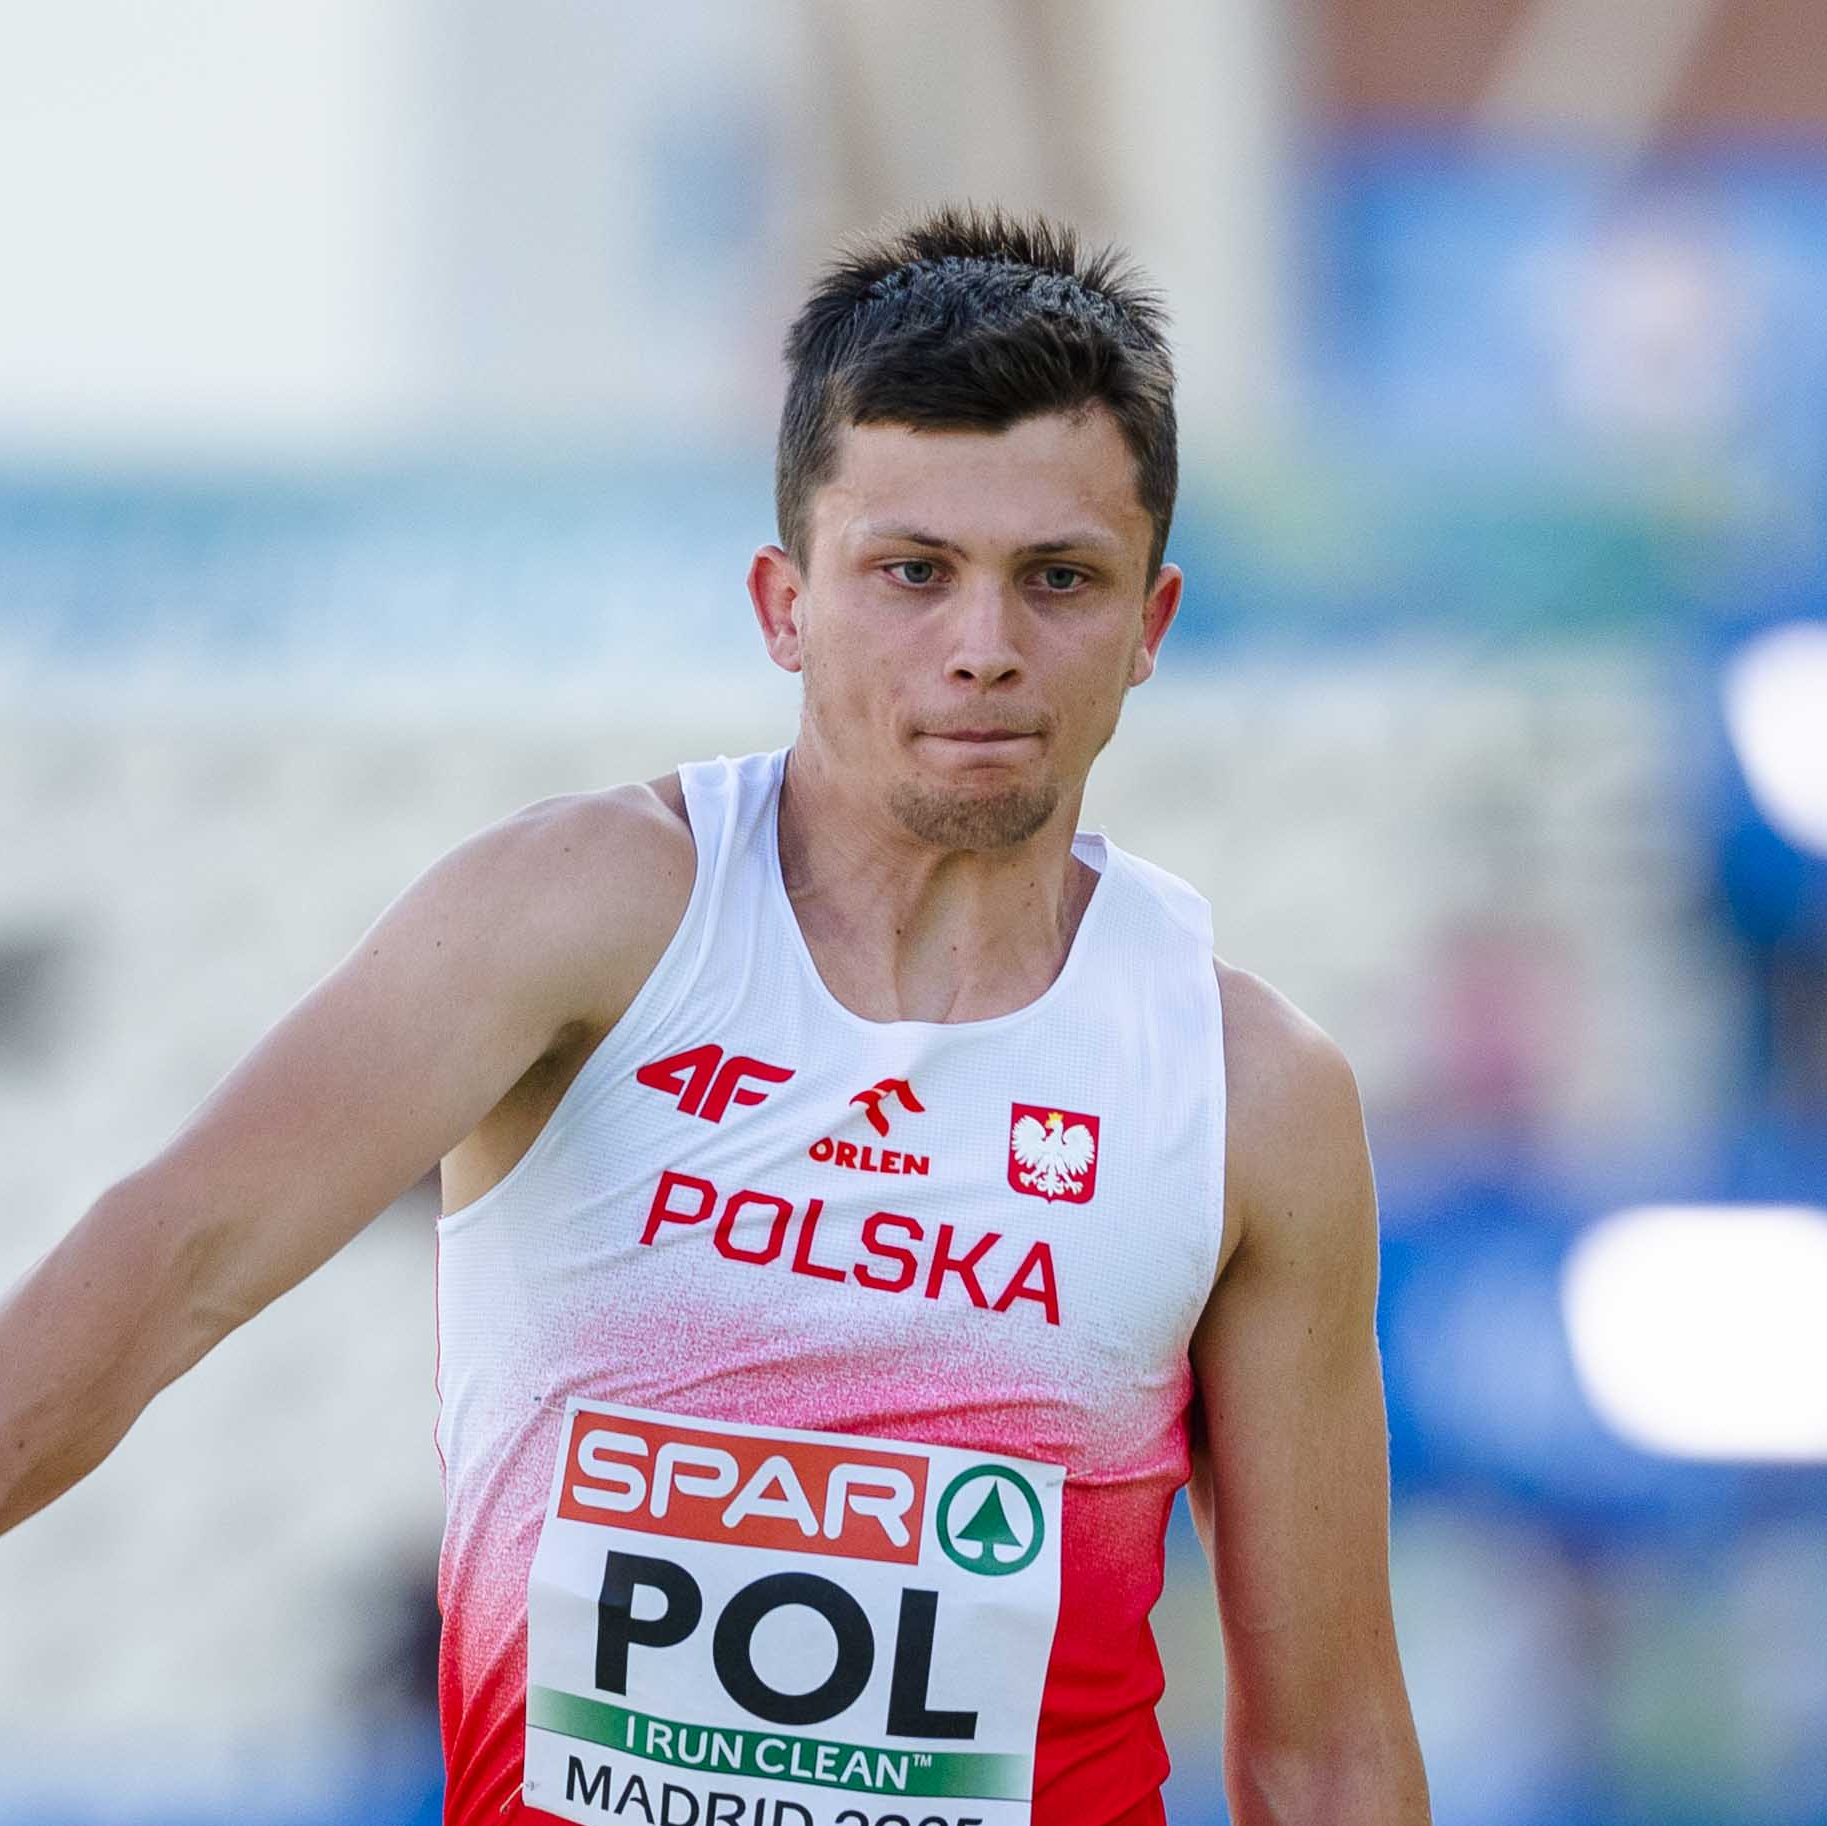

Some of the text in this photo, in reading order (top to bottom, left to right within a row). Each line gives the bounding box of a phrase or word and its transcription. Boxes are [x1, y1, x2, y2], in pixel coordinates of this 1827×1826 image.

[636, 1043, 796, 1124] 4F
[808, 1136, 930, 1177] ORLEN
[640, 1169, 1060, 1326] POLSKA
[572, 1428, 915, 1548] SPAR
[594, 1549, 979, 1740] POL
[625, 1716, 638, 1750] I
[645, 1720, 744, 1770] RUN
